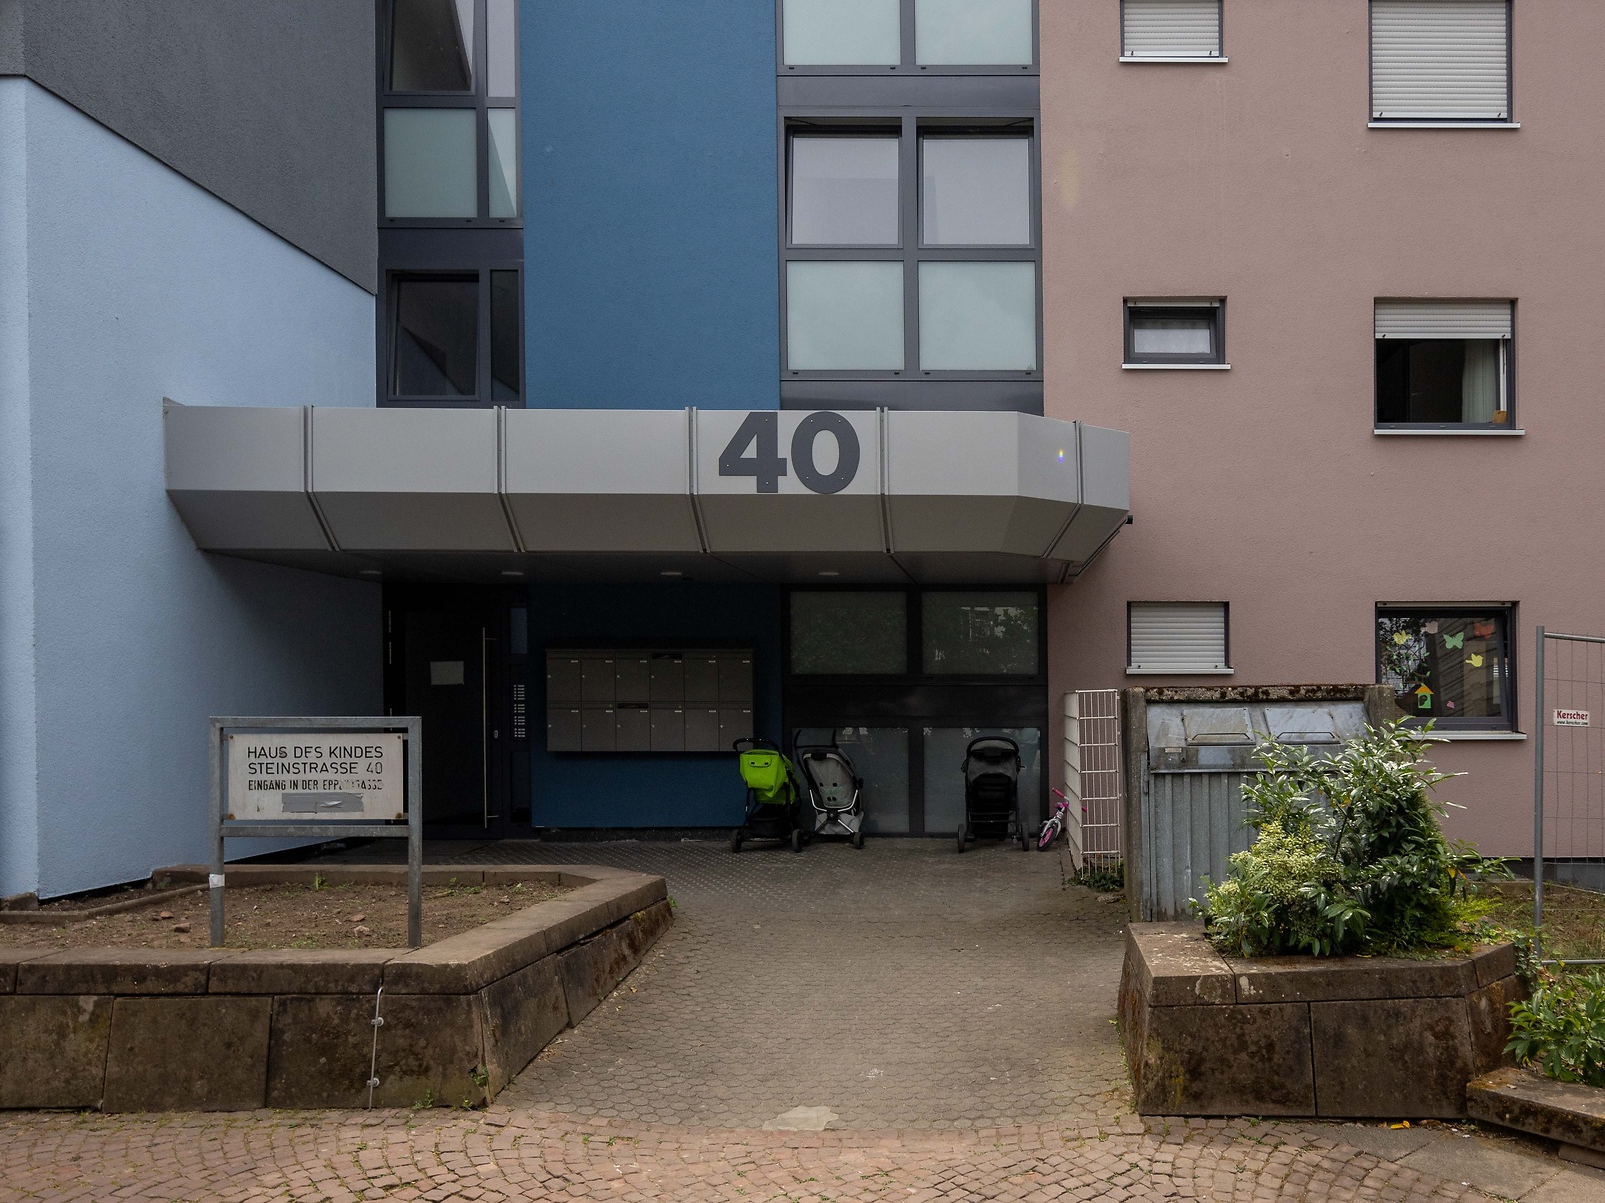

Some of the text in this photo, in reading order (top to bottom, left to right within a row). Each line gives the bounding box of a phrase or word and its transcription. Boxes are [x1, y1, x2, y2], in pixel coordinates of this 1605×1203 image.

[718, 411, 861, 494] 40
[1556, 710, 1588, 720] Kerscher
[247, 746, 383, 759] HAUS DES KINDES
[248, 762, 383, 775] STEINSTRASSE 40
[248, 779, 286, 791] EINGANG
[289, 779, 299, 791] IN
[301, 779, 319, 791] DER
